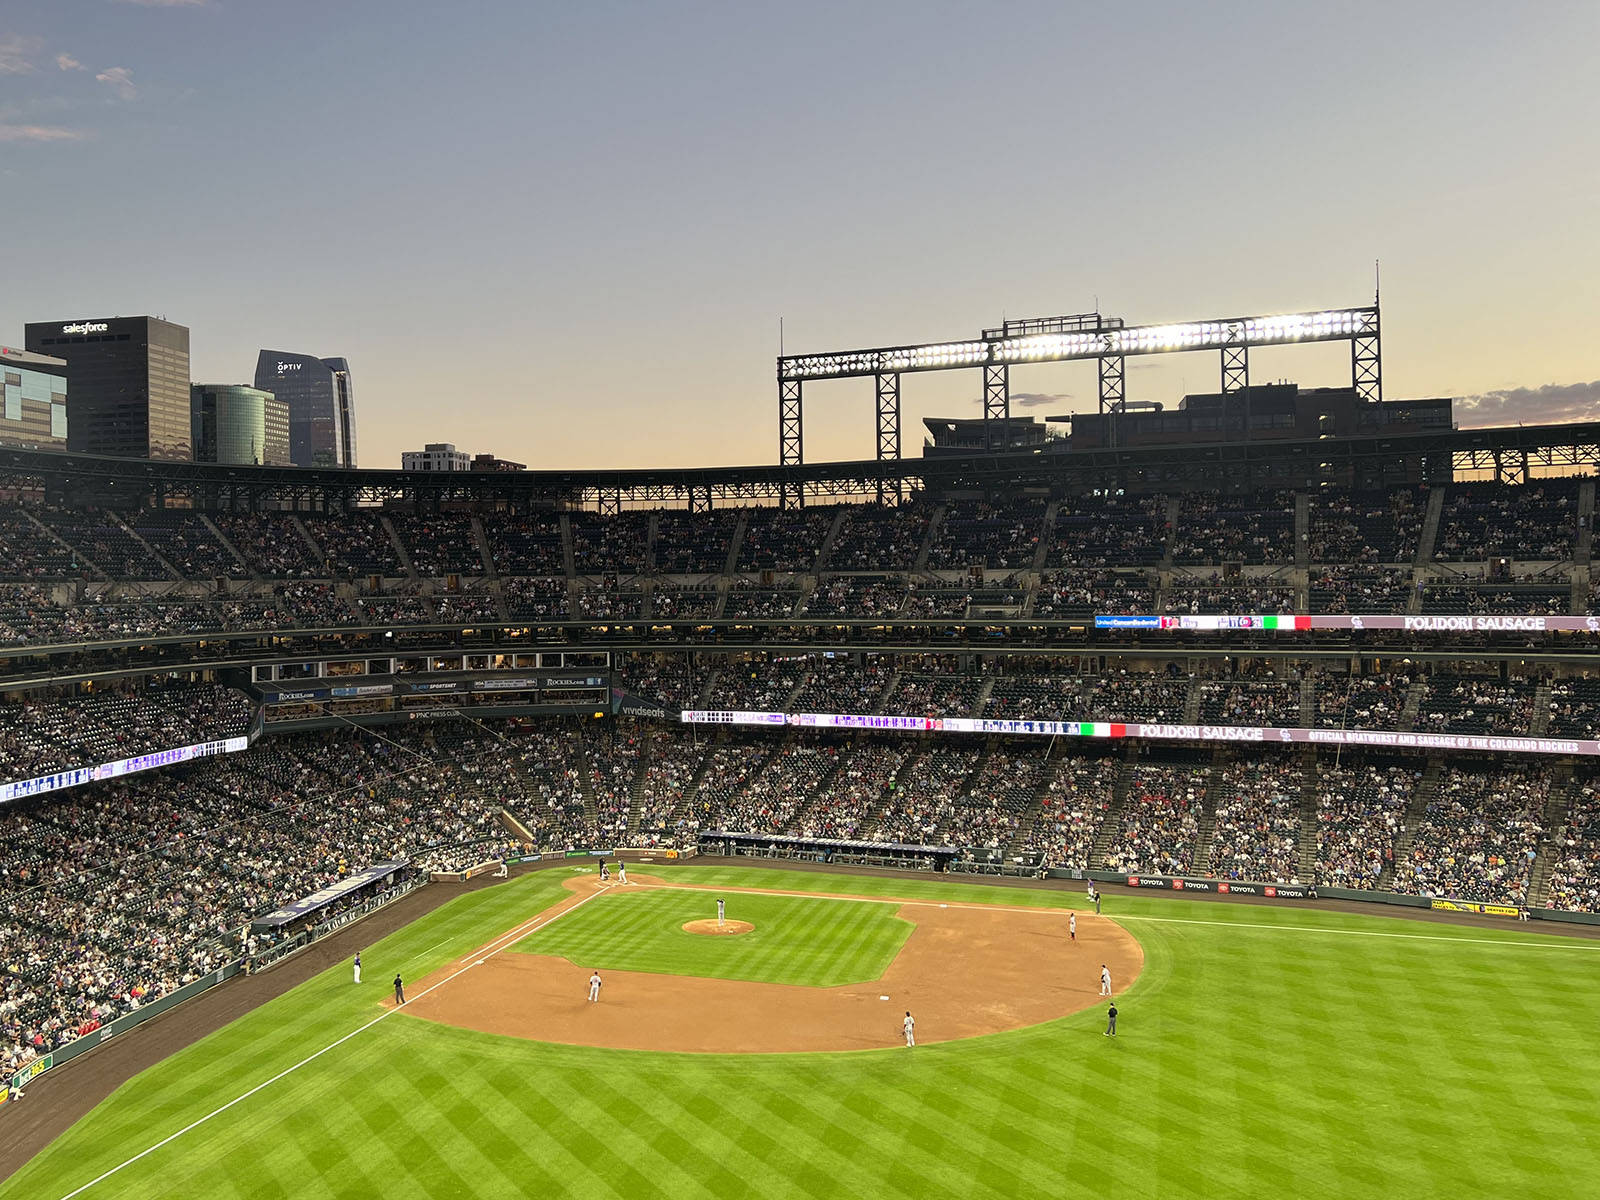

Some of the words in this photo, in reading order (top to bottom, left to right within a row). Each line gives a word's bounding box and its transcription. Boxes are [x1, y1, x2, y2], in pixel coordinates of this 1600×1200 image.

[63, 322, 108, 334] salesforce
[277, 362, 302, 372] OPTIV
[1404, 617, 1473, 629] POLIDORI
[1476, 617, 1546, 630] SAUSAGE
[622, 706, 665, 718] vividseats
[1139, 725, 1200, 738] POLIDORI
[1202, 727, 1264, 740] SAUSAGE
[1309, 731, 1345, 741] OFFICIAL
[1346, 733, 1396, 744] BRATWURST
[1398, 735, 1416, 745] AND
[1417, 736, 1456, 747] SAUSAGE
[1458, 738, 1470, 747] OF
[1470, 739, 1488, 748] THE
[1490, 740, 1537, 750] COLORADO
[1539, 742, 1579, 752] ROCKIES
[1184, 882, 1209, 890] TOYOTA
[1230, 885, 1255, 894] TOYOTA
[1277, 889, 1303, 897] TOYOTA
[20, 1060, 45, 1085] bet365
